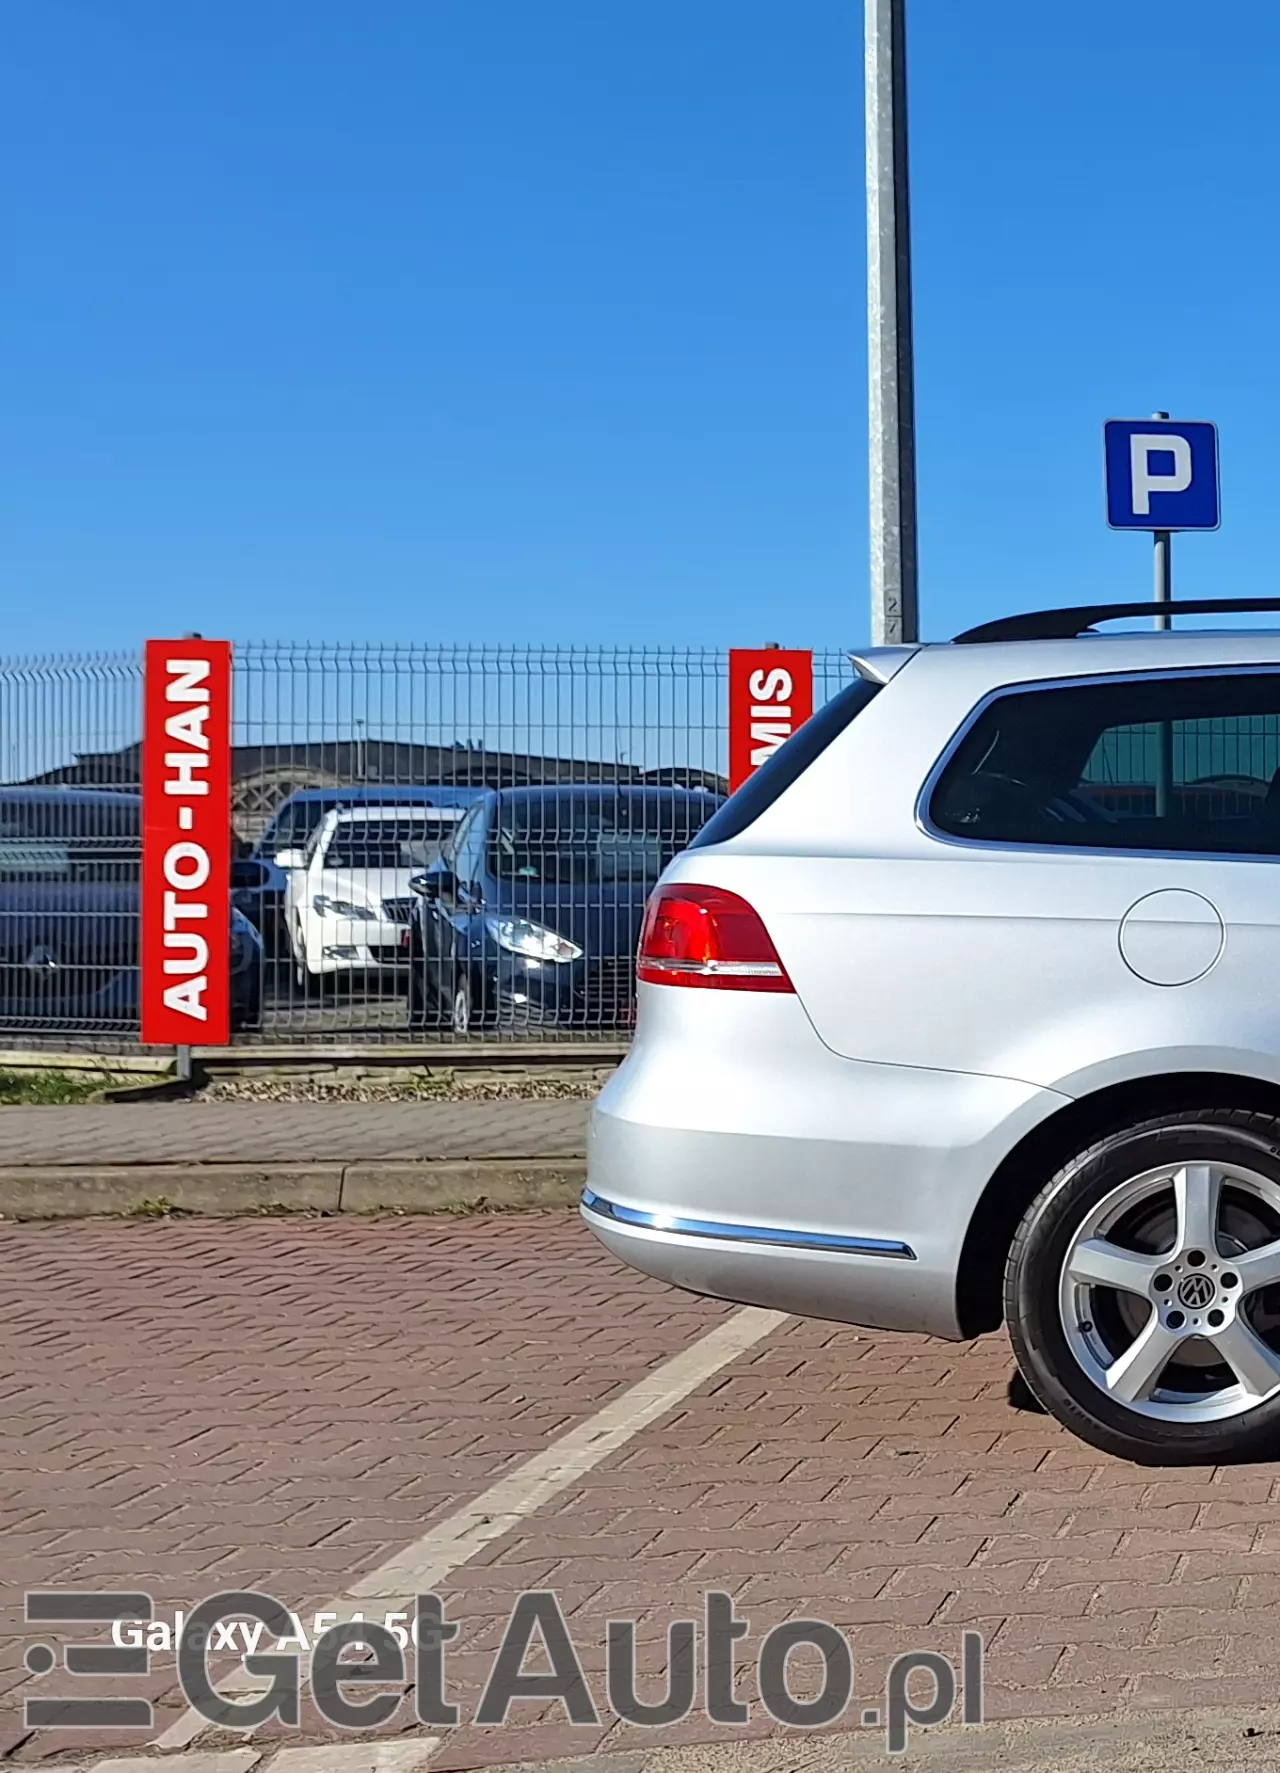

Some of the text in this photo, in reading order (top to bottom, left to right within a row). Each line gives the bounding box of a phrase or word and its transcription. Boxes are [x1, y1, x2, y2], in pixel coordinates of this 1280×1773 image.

[1130, 433, 1192, 515] P
[887, 597, 898, 613] 2
[887, 619, 898, 634] 7
